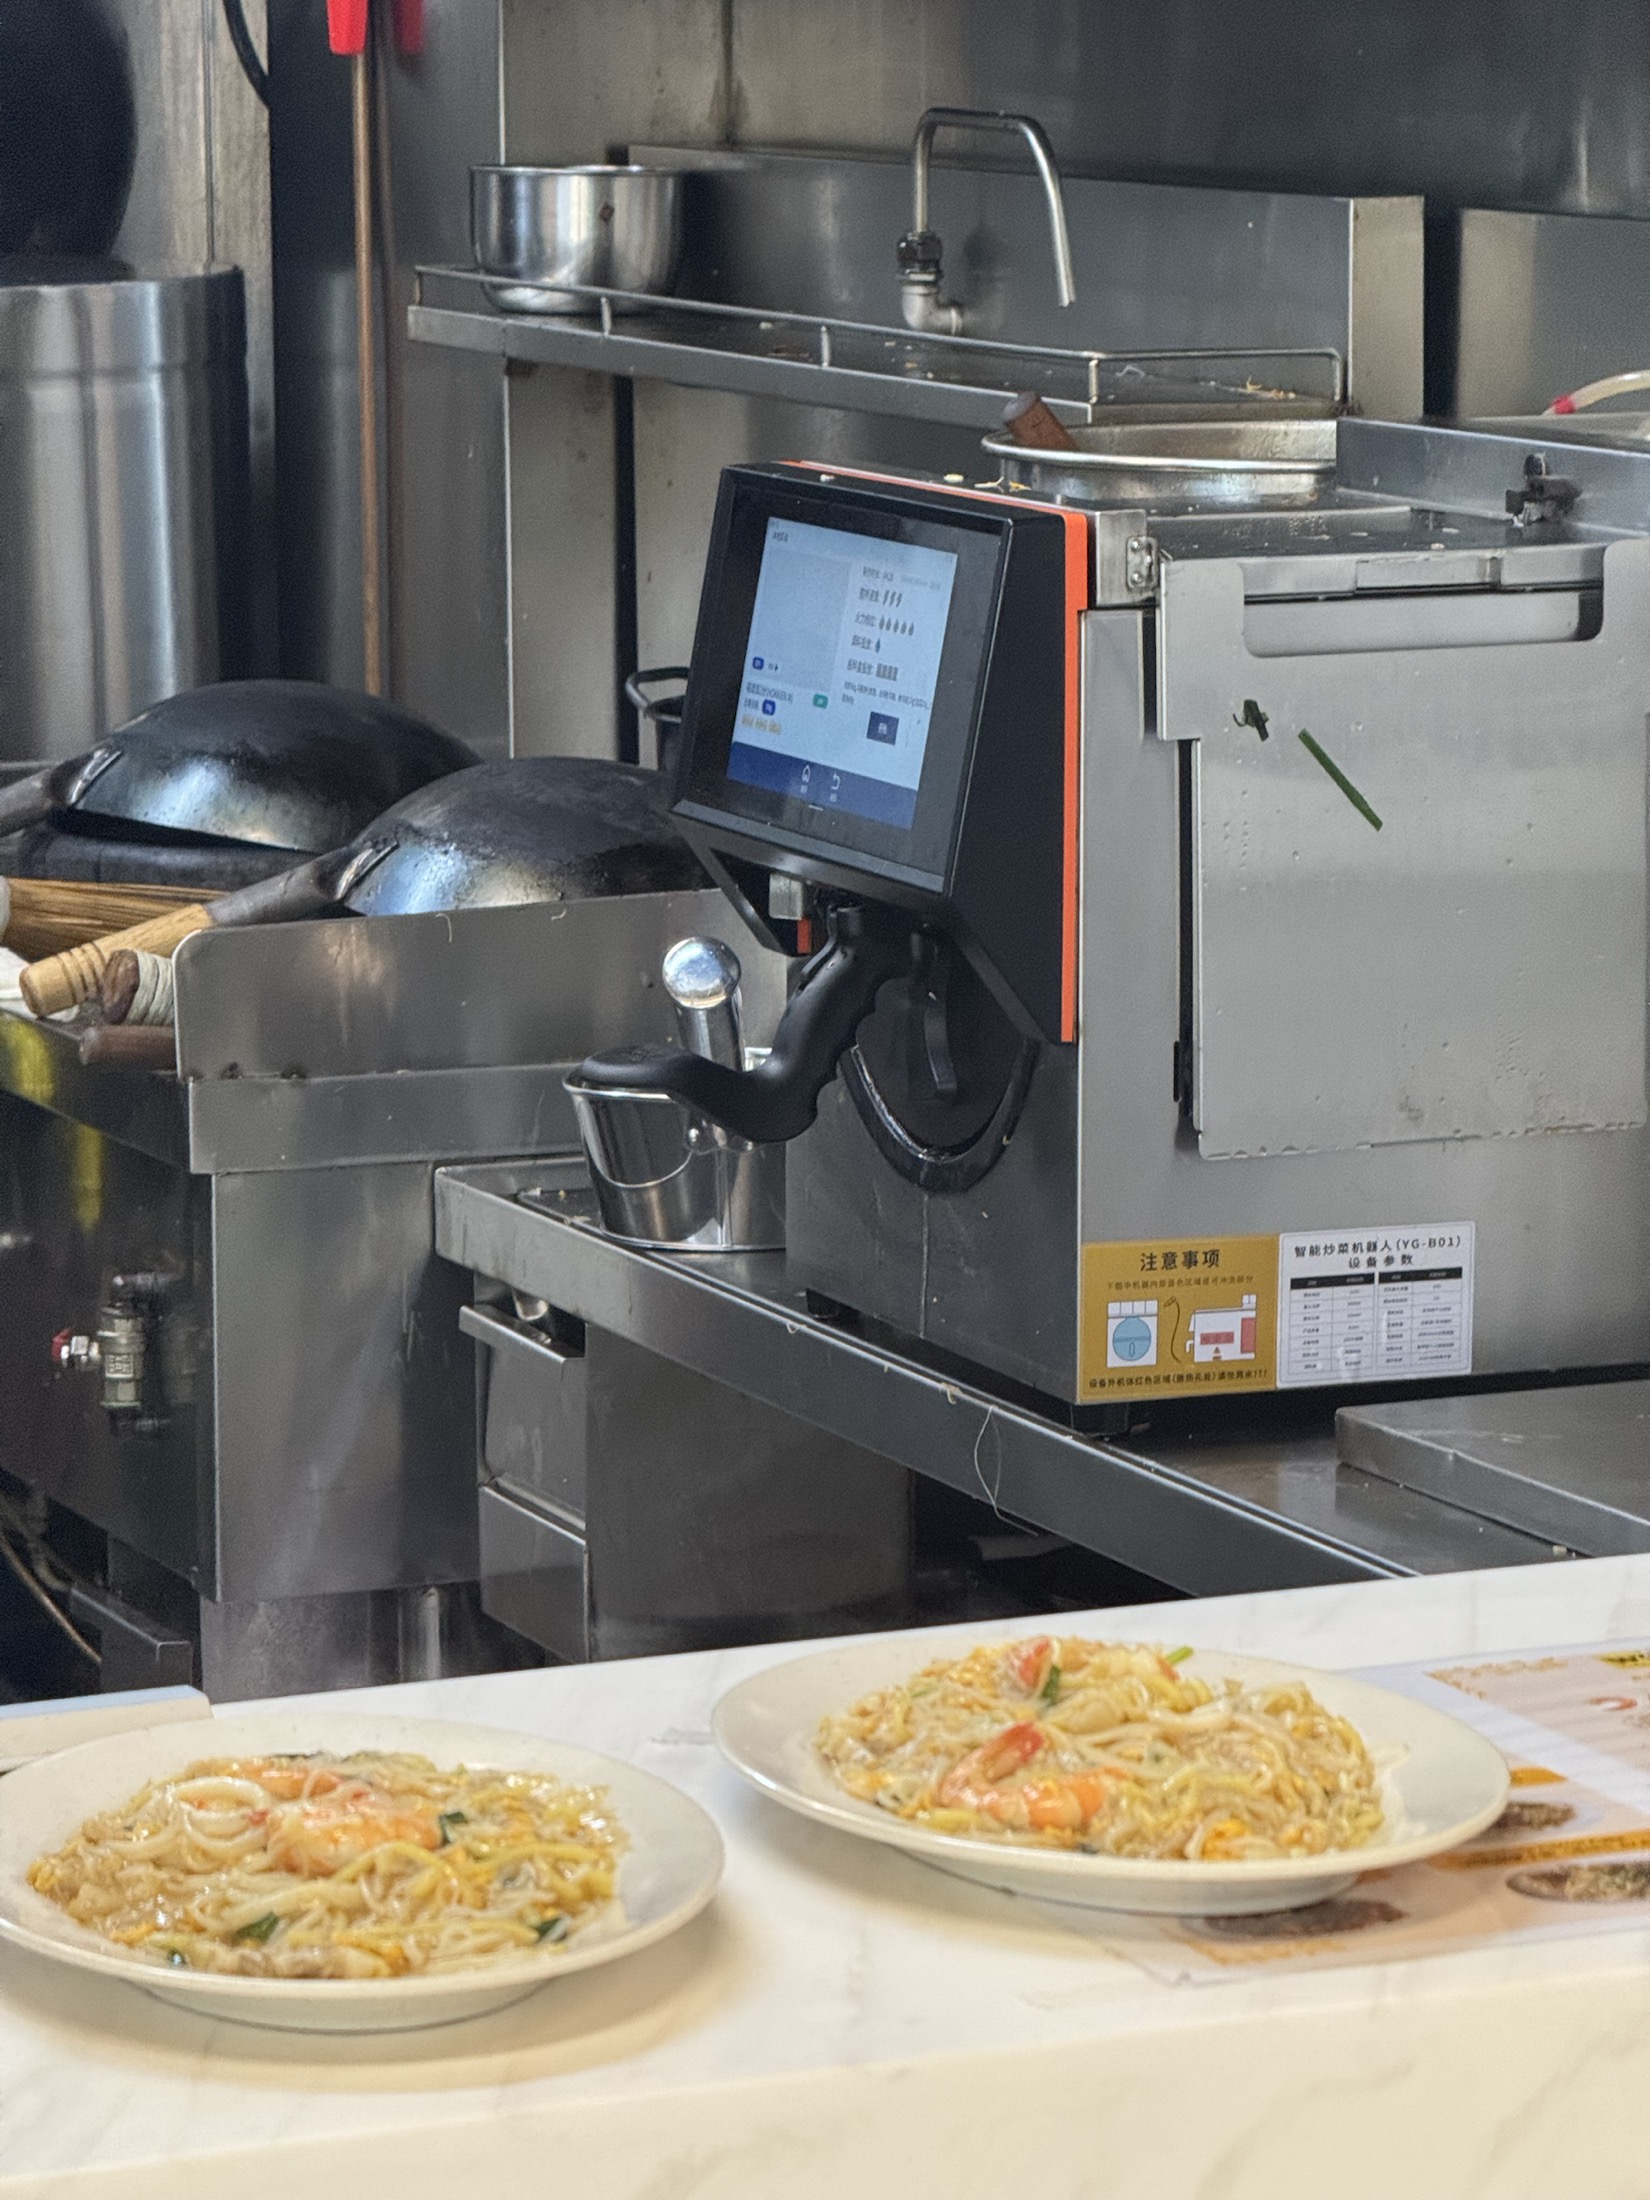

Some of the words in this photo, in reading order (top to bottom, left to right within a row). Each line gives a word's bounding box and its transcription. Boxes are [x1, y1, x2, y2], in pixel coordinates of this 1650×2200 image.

[1294, 1235, 1461, 1257] 智能炒菜机器人(YG-B01)
[1140, 1248, 1220, 1271] 注意事项
[1348, 1254, 1413, 1269] 设备参数
